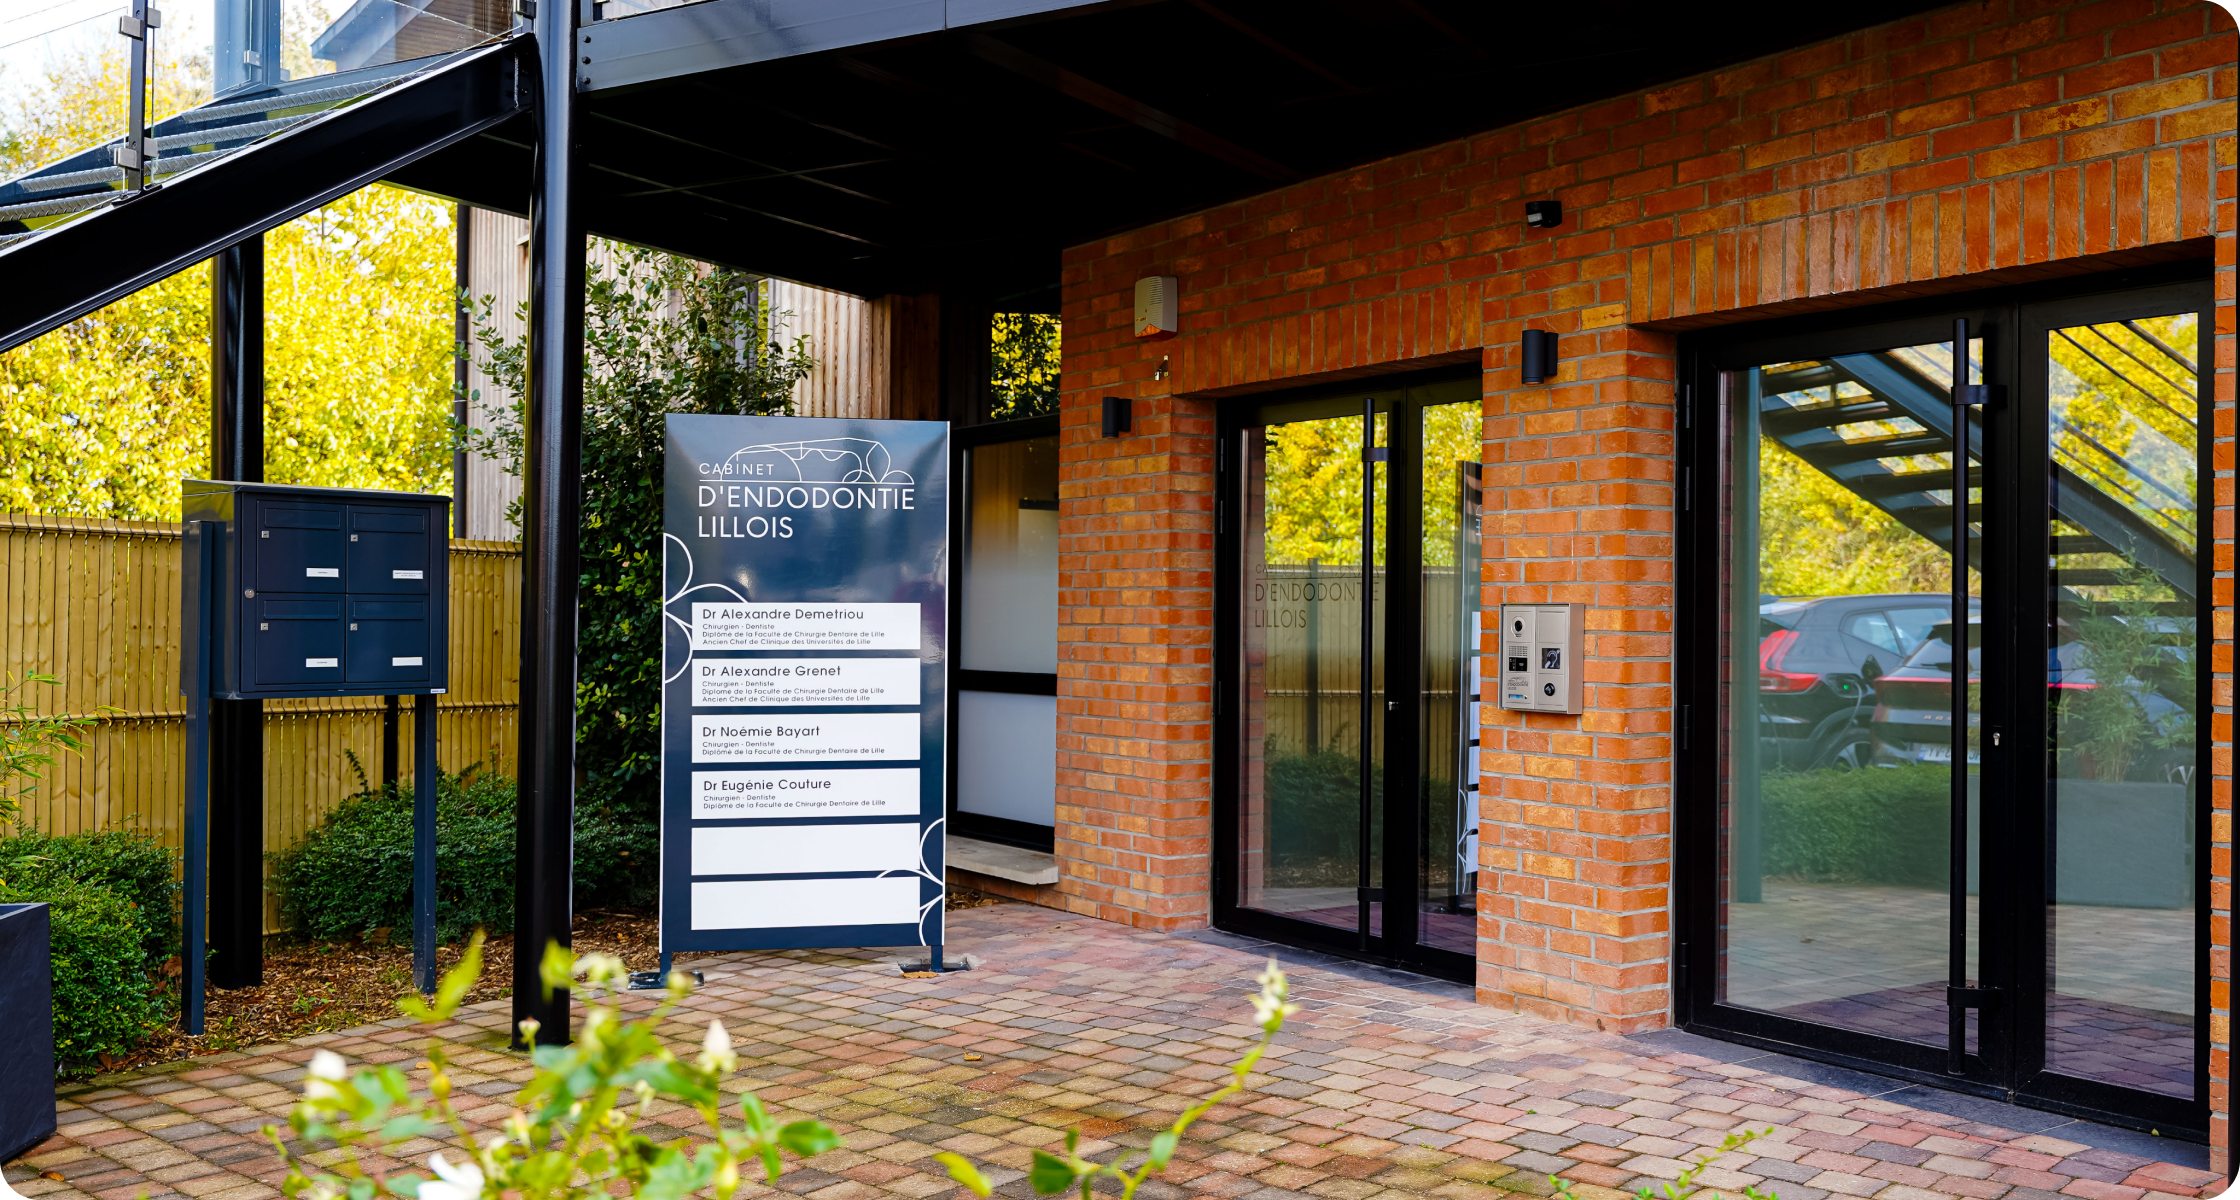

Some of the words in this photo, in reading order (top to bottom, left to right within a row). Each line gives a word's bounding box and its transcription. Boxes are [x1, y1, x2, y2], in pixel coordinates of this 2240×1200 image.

[699, 462, 774, 475] CABINET
[698, 486, 915, 510] D'ENDODONTIE
[698, 516, 794, 538] LILLOIS
[1256, 583, 1379, 601] D'ENDODONTE
[703, 609, 716, 619] Dr
[721, 609, 790, 619] Alexandre
[796, 609, 863, 619] Demetriou
[1256, 610, 1306, 627] LILLOIS
[703, 667, 715, 676] Dr
[721, 666, 790, 676] Alexandre
[795, 666, 840, 676] Grenet
[703, 727, 716, 737] Dr
[721, 727, 772, 736] Noémie
[777, 726, 819, 738] Bayart
[704, 781, 717, 790] Dr
[722, 780, 773, 793] Eugénie
[779, 779, 831, 789] Couture
